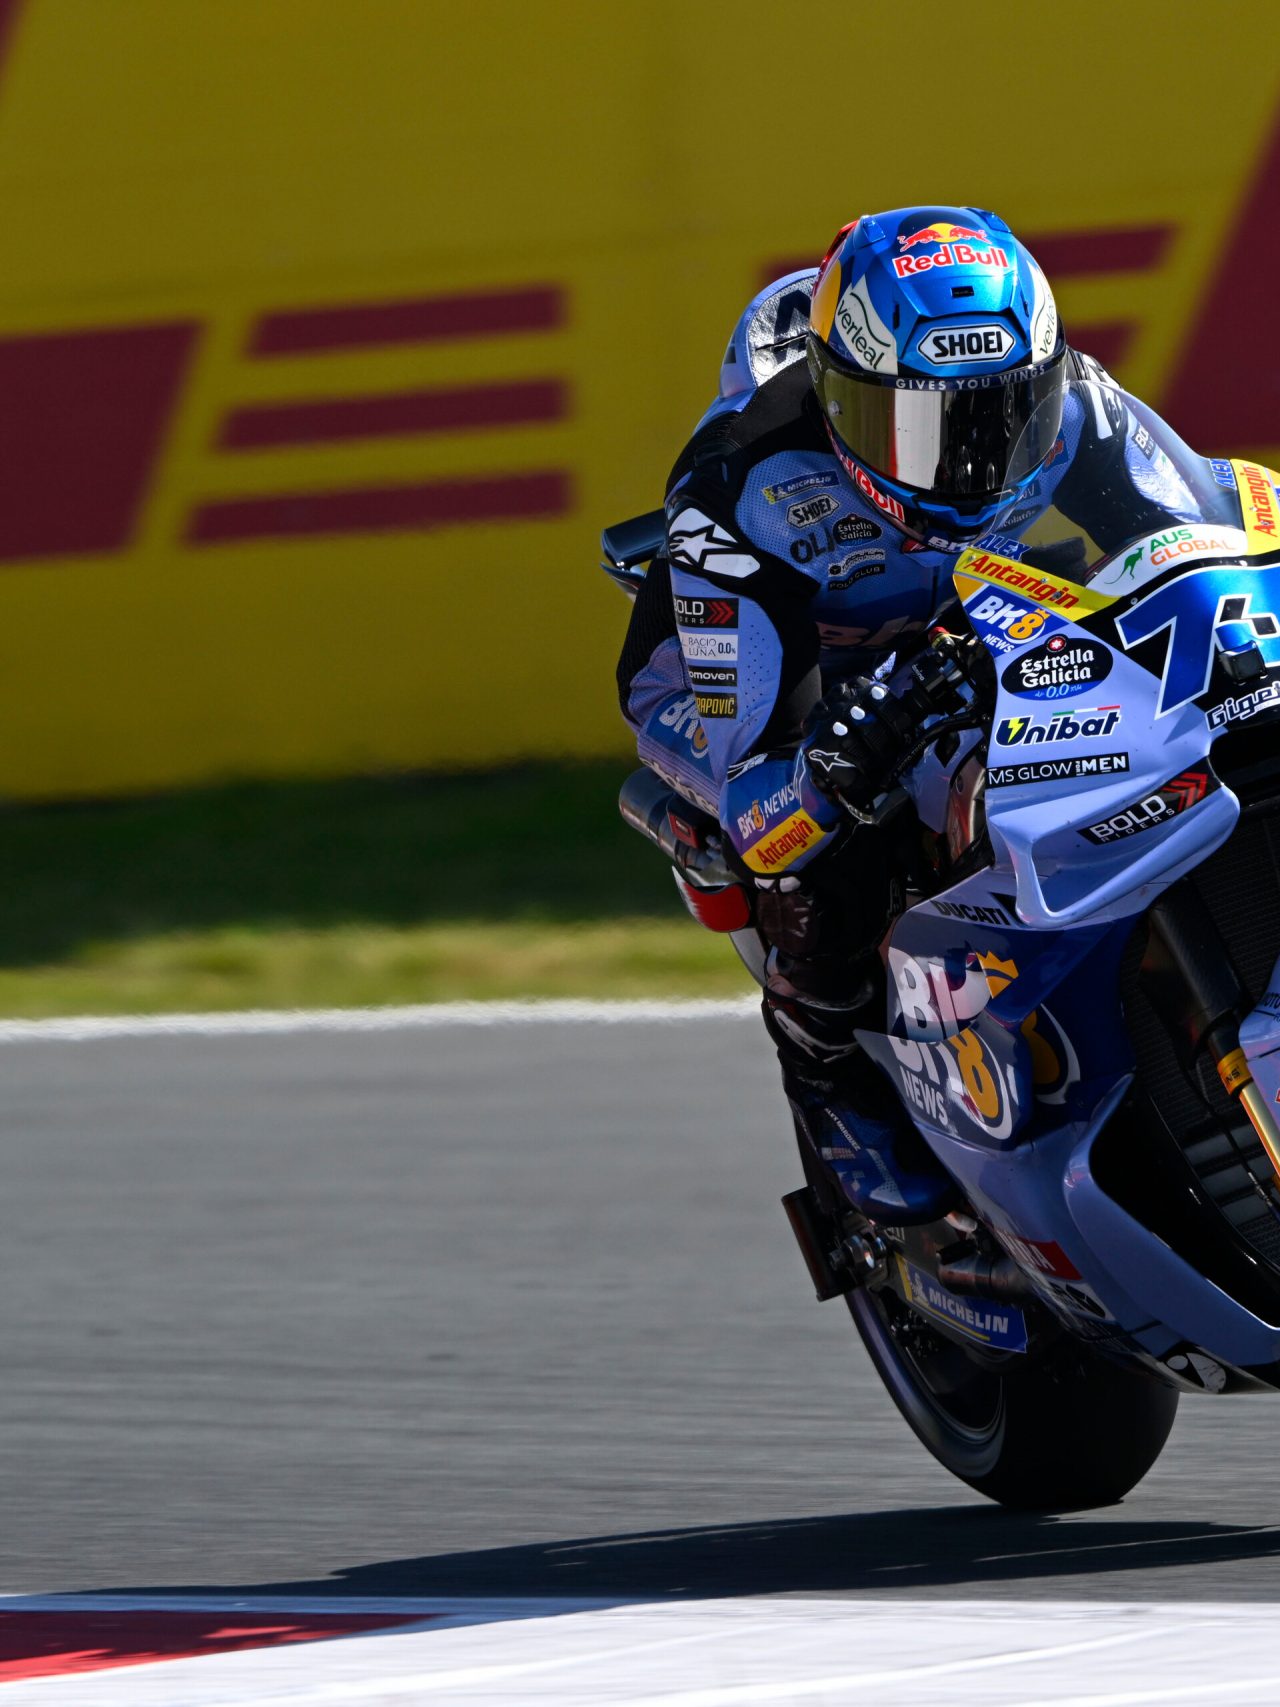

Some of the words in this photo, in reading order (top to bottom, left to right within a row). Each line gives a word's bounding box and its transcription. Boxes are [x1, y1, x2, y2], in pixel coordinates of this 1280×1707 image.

[892, 246, 950, 278] Red
[955, 244, 1009, 269] Bull
[836, 299, 885, 371] verleal
[932, 331, 1002, 358] SHOEI
[895, 378, 946, 391] GIVES
[956, 378, 991, 390] YOU
[1000, 364, 1046, 386] WINGS
[792, 497, 832, 524] SHOEI
[1239, 464, 1279, 538] Antangin
[972, 533, 1032, 563] ALEX
[1150, 528, 1193, 553] AUS
[1150, 538, 1236, 567] GLOBAL
[963, 554, 1080, 609] Antangin
[969, 594, 1047, 641] BK8
[983, 632, 1016, 653] NEWS
[1019, 648, 1095, 674] Estrella
[1022, 665, 1092, 688] Galicia
[1045, 683, 1070, 698] 0,0
[995, 710, 1122, 748] Unibat
[988, 767, 1014, 786] MS
[1017, 761, 1073, 781] GLOW
[1082, 755, 1128, 773] MEN
[763, 781, 796, 817] NEWS
[1089, 794, 1167, 839] BOLD
[1100, 807, 1176, 843] RIDERS
[756, 817, 815, 870] Antangin
[929, 899, 1011, 926] DUCATI
[900, 1066, 949, 1126] NEWS
[928, 1286, 1009, 1335] MICHELIN
